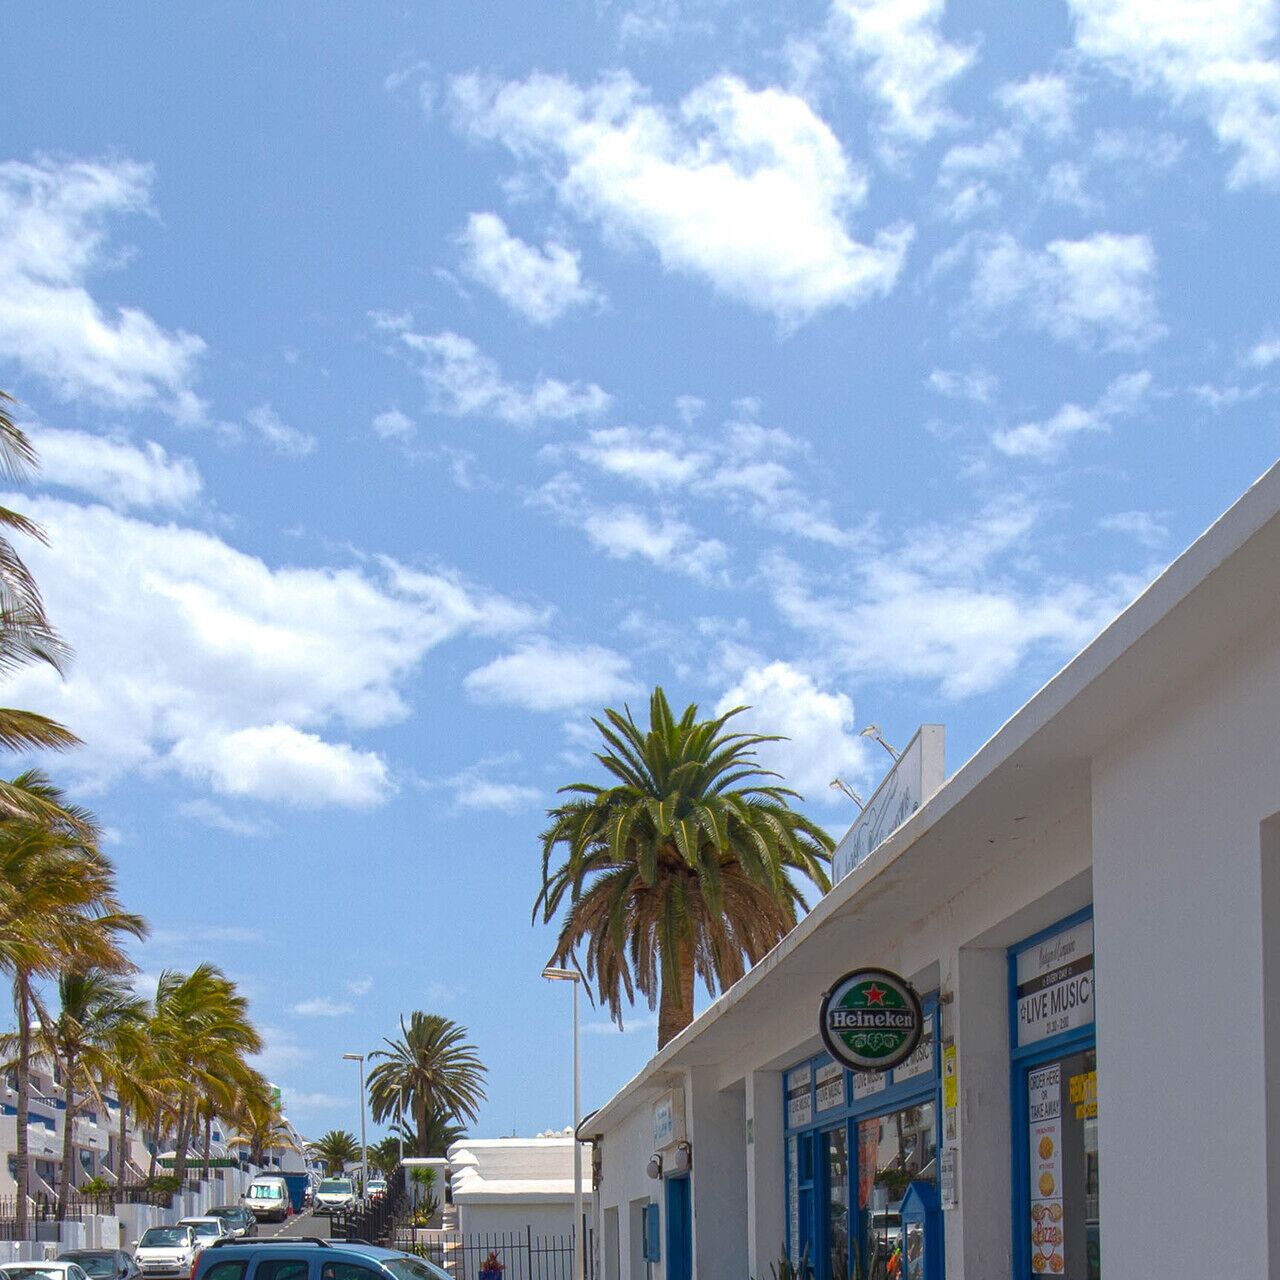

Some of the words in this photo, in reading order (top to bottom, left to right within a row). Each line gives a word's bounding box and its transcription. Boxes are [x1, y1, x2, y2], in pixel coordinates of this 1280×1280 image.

[1026, 992, 1048, 1024] LIVE
[1050, 976, 1090, 1016] MUSIC
[833, 1011, 913, 1027] Heineken
[1030, 1073, 1046, 1090] ORDER
[1046, 1069, 1059, 1086] HERE
[1030, 1103, 1045, 1120] TAKE
[1045, 1100, 1059, 1116] AWAY
